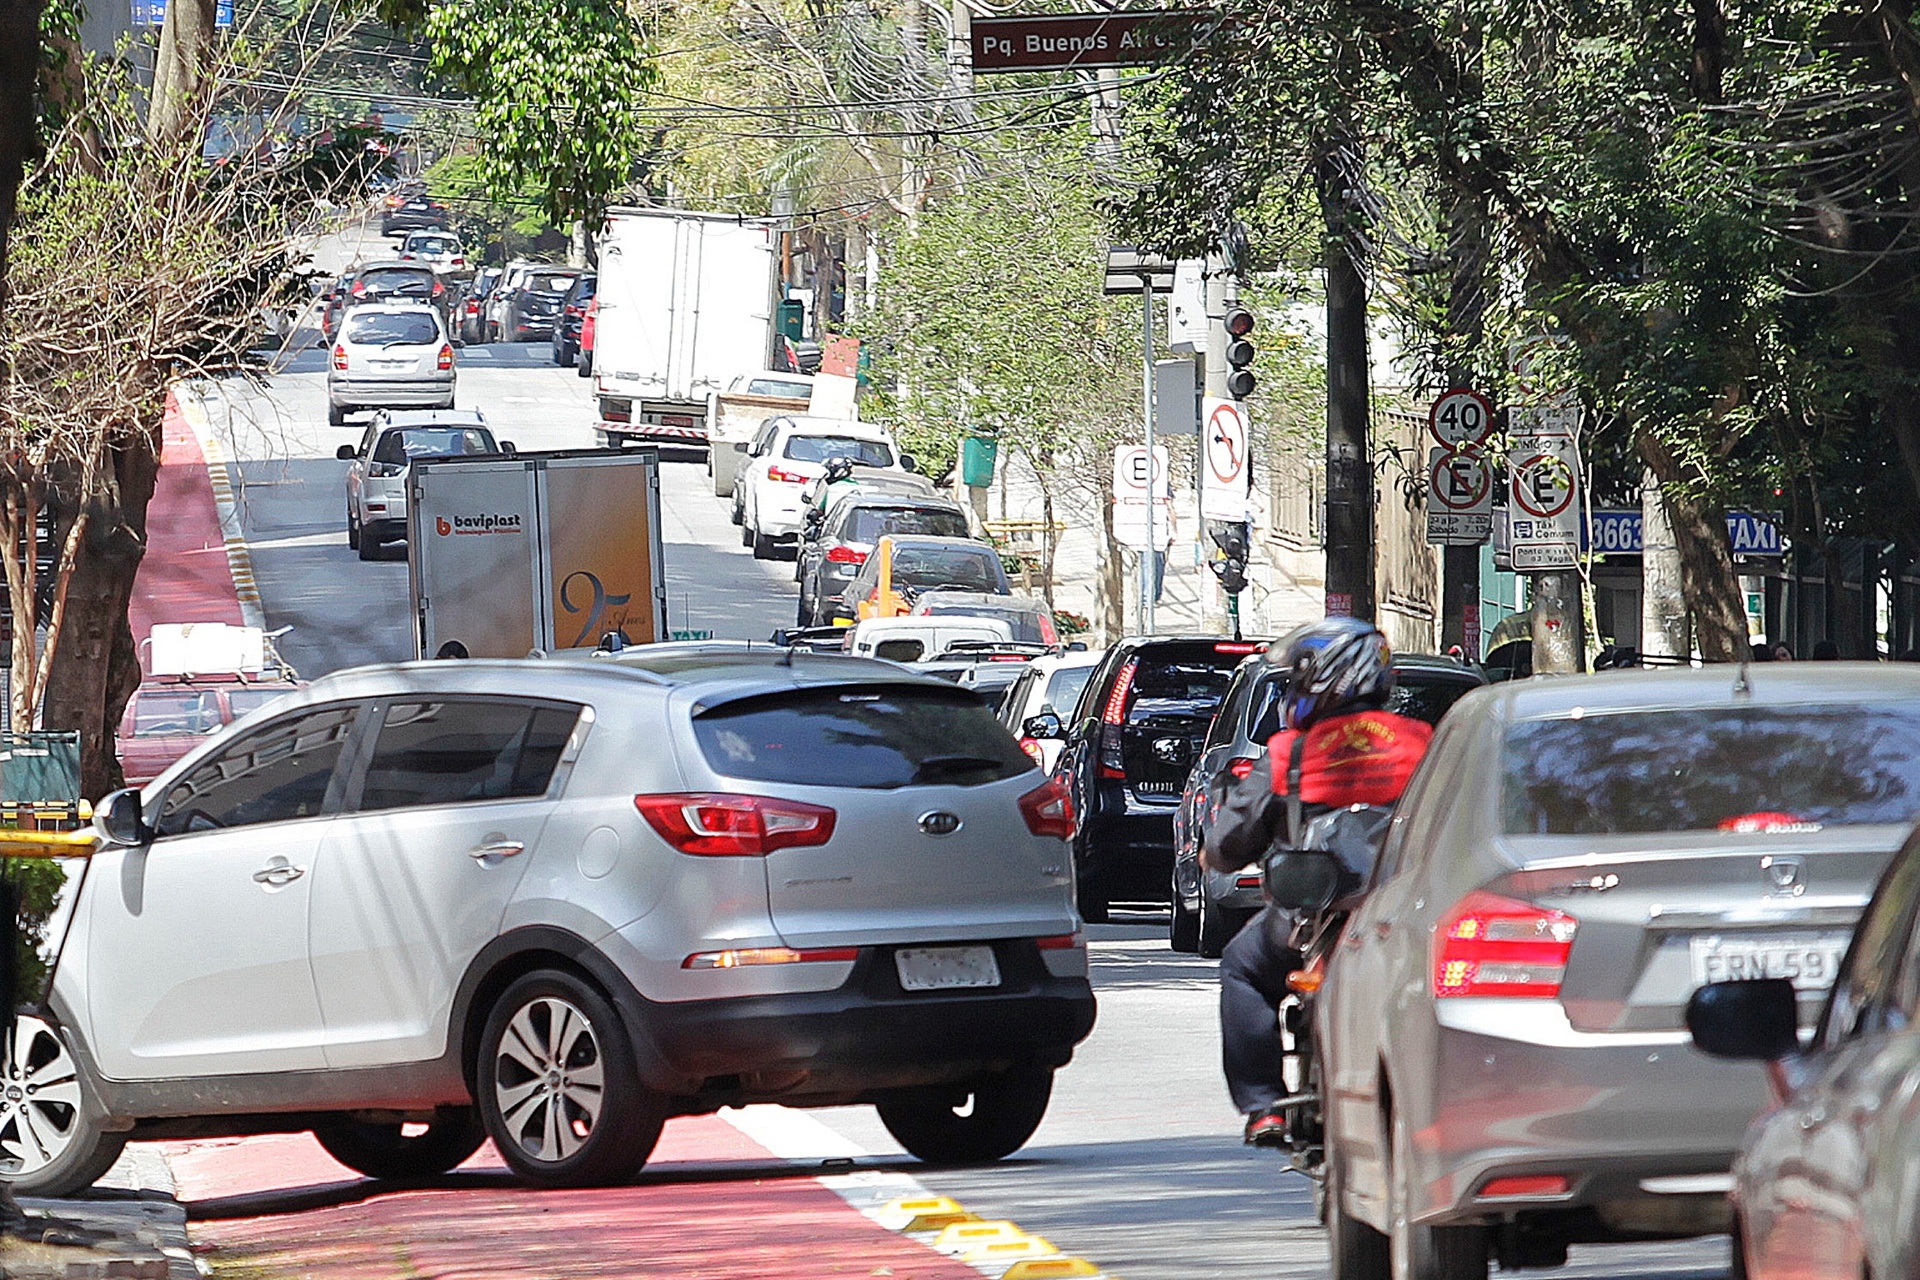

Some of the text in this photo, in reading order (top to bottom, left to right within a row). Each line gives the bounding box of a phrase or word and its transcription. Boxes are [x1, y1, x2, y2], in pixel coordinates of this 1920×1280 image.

[983, 36, 1016, 55] Pq.
[1026, 33, 1108, 53] Buenos
[1440, 403, 1481, 431] 40
[454, 513, 521, 529] baviplast
[1727, 518, 1776, 549] TAXI
[672, 630, 708, 641] TAXI
